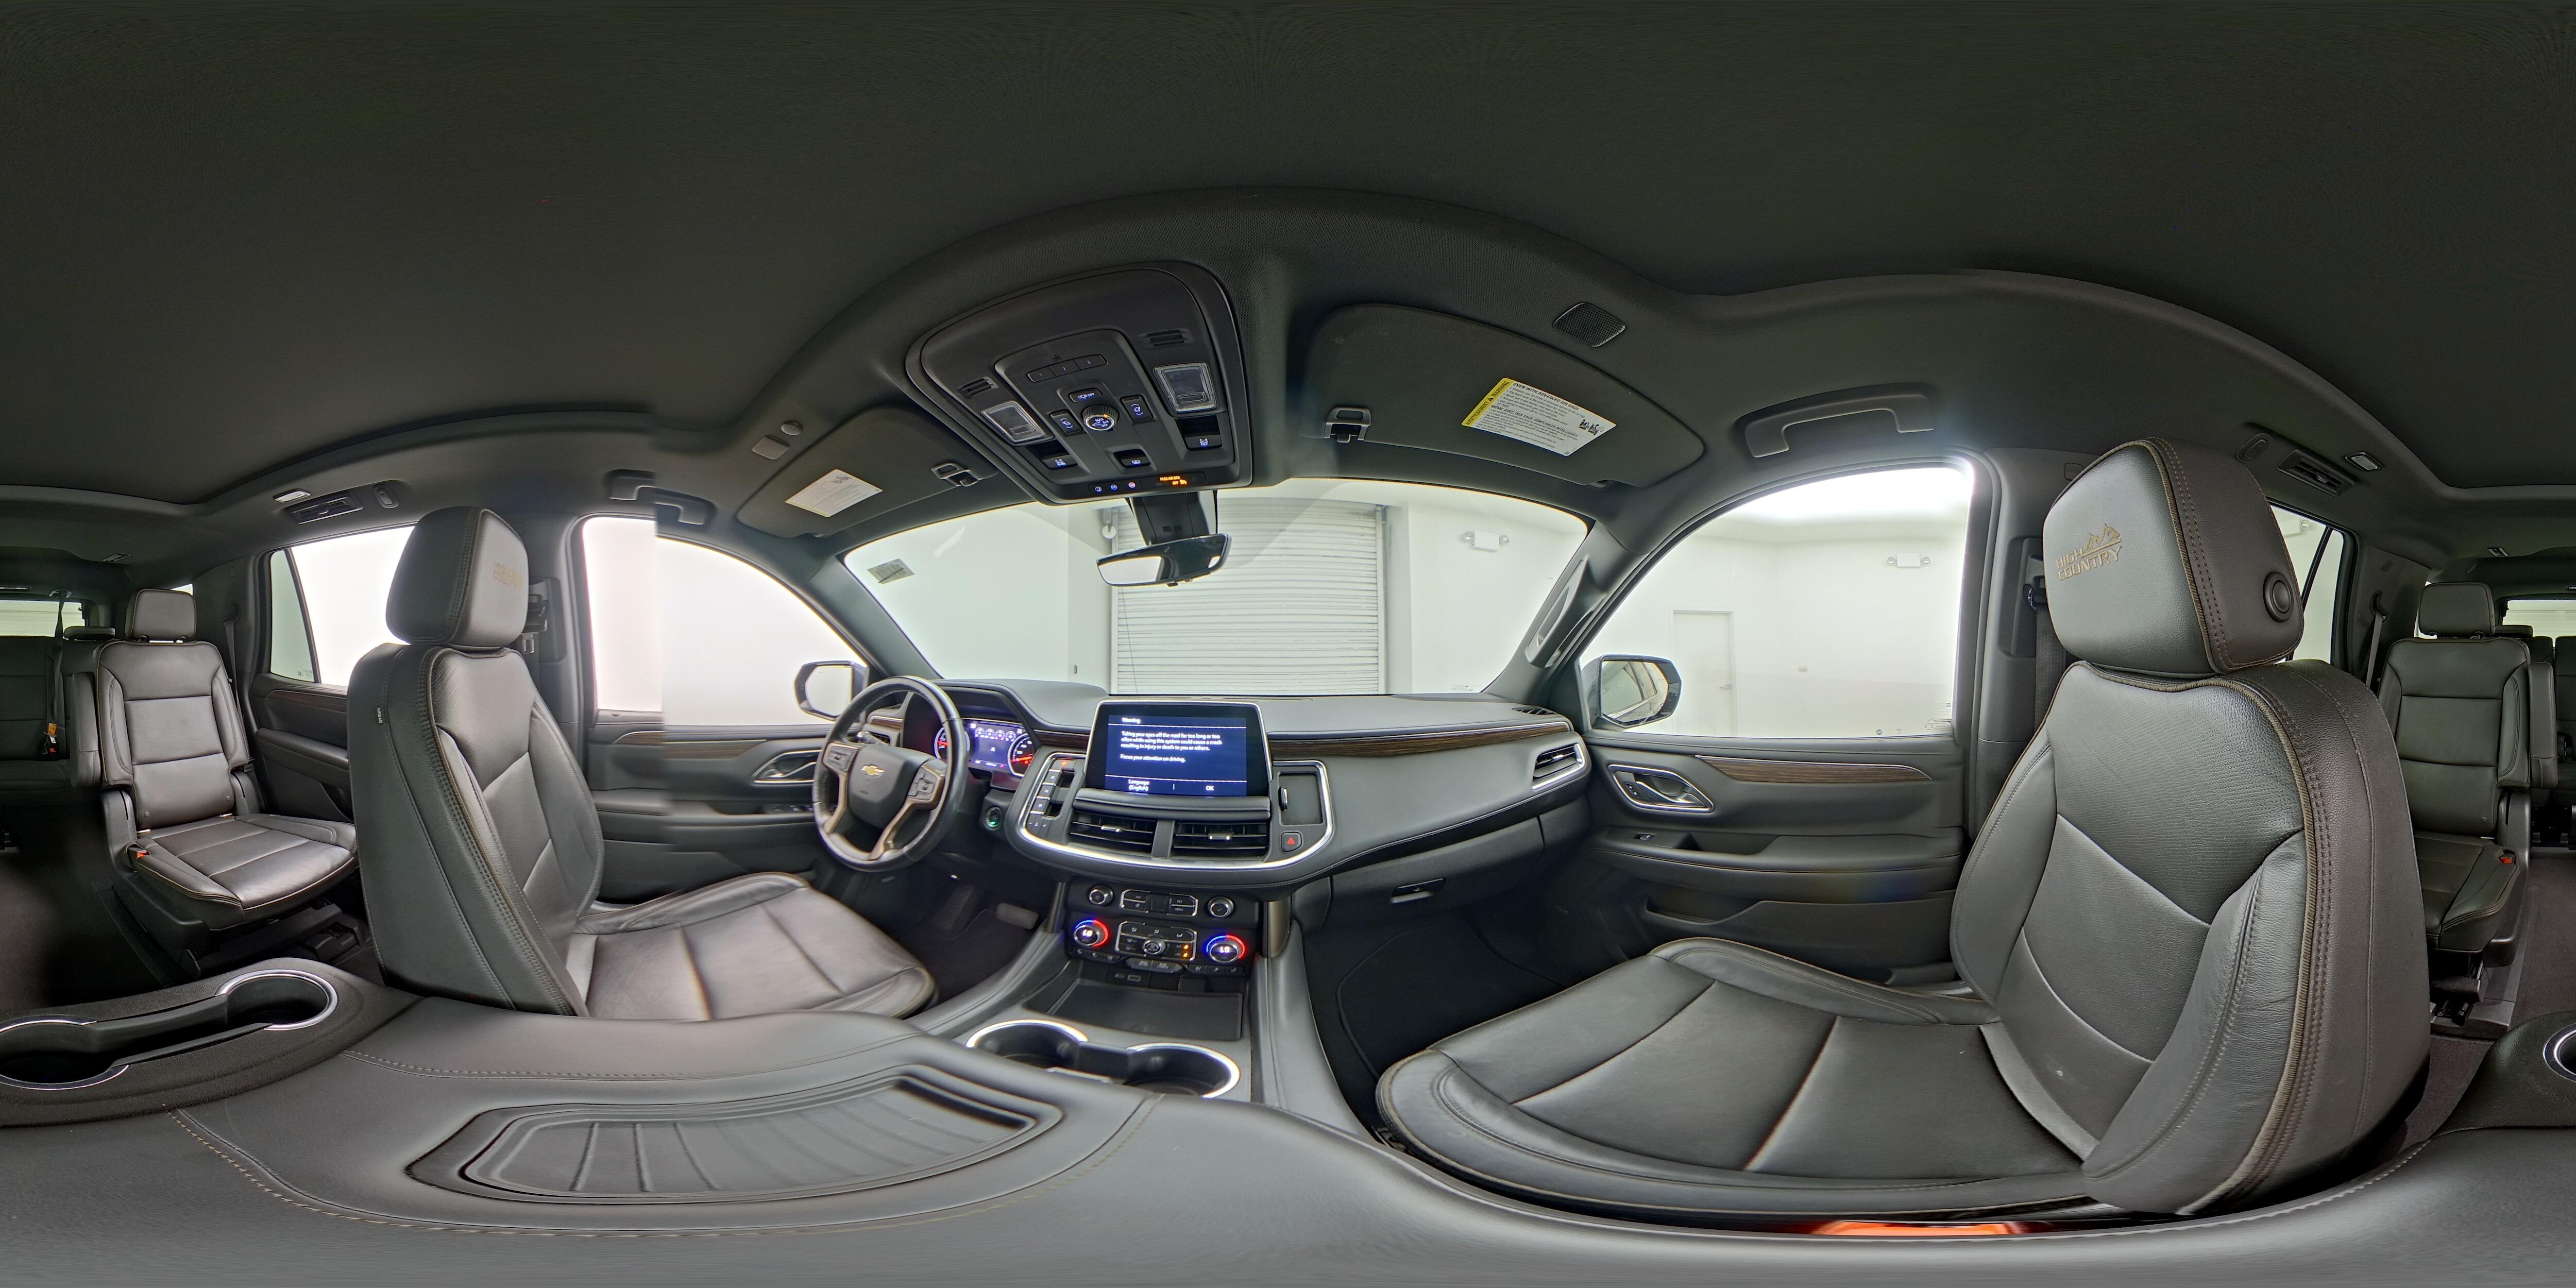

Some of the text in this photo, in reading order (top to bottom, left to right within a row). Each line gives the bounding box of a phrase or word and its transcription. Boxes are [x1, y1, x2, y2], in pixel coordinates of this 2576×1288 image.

[1465, 401, 1489, 426] AVERTISSEMENT
[1491, 381, 1510, 397] WARNING
[1538, 390, 1561, 402] ADVANCED
[1555, 426, 1578, 437] INTELLIGENTS
[2056, 547, 2083, 568] HIGH
[2058, 546, 2122, 581] COUNTRY
